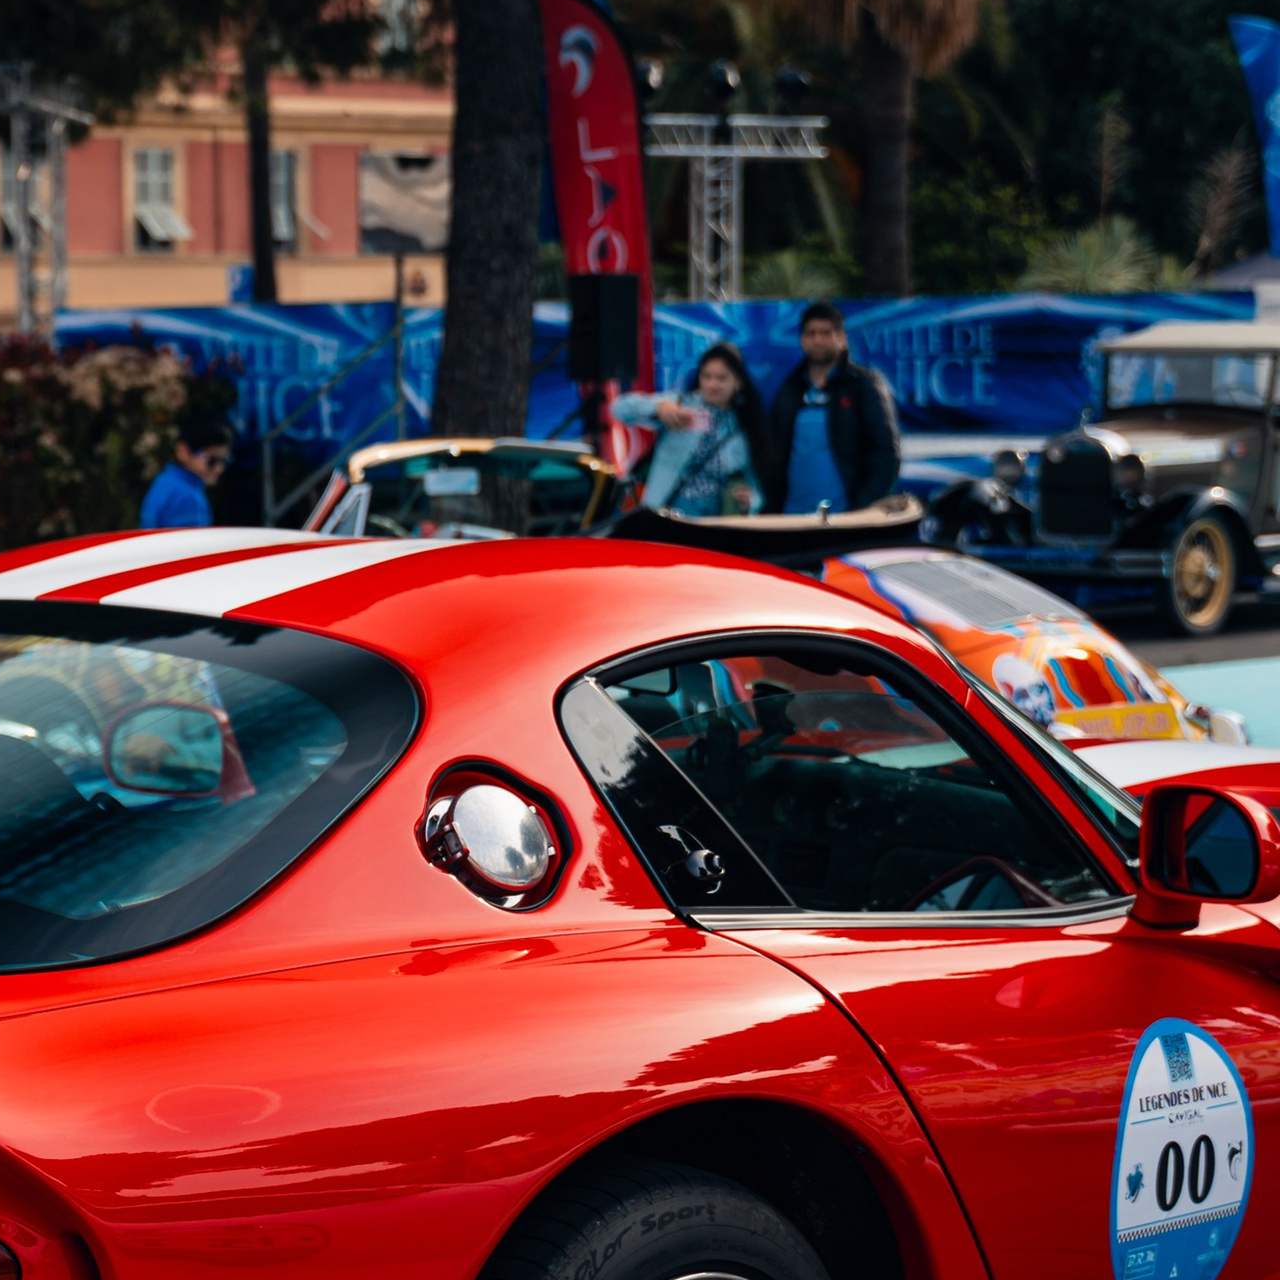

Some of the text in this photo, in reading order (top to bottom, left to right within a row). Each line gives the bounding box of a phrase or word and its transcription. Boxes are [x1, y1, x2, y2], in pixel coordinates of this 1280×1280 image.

[860, 322, 993, 354] VILLE DE
[1139, 1081, 1228, 1113] LEGENDES DE NICE
[1155, 1134, 1216, 1212] 00
